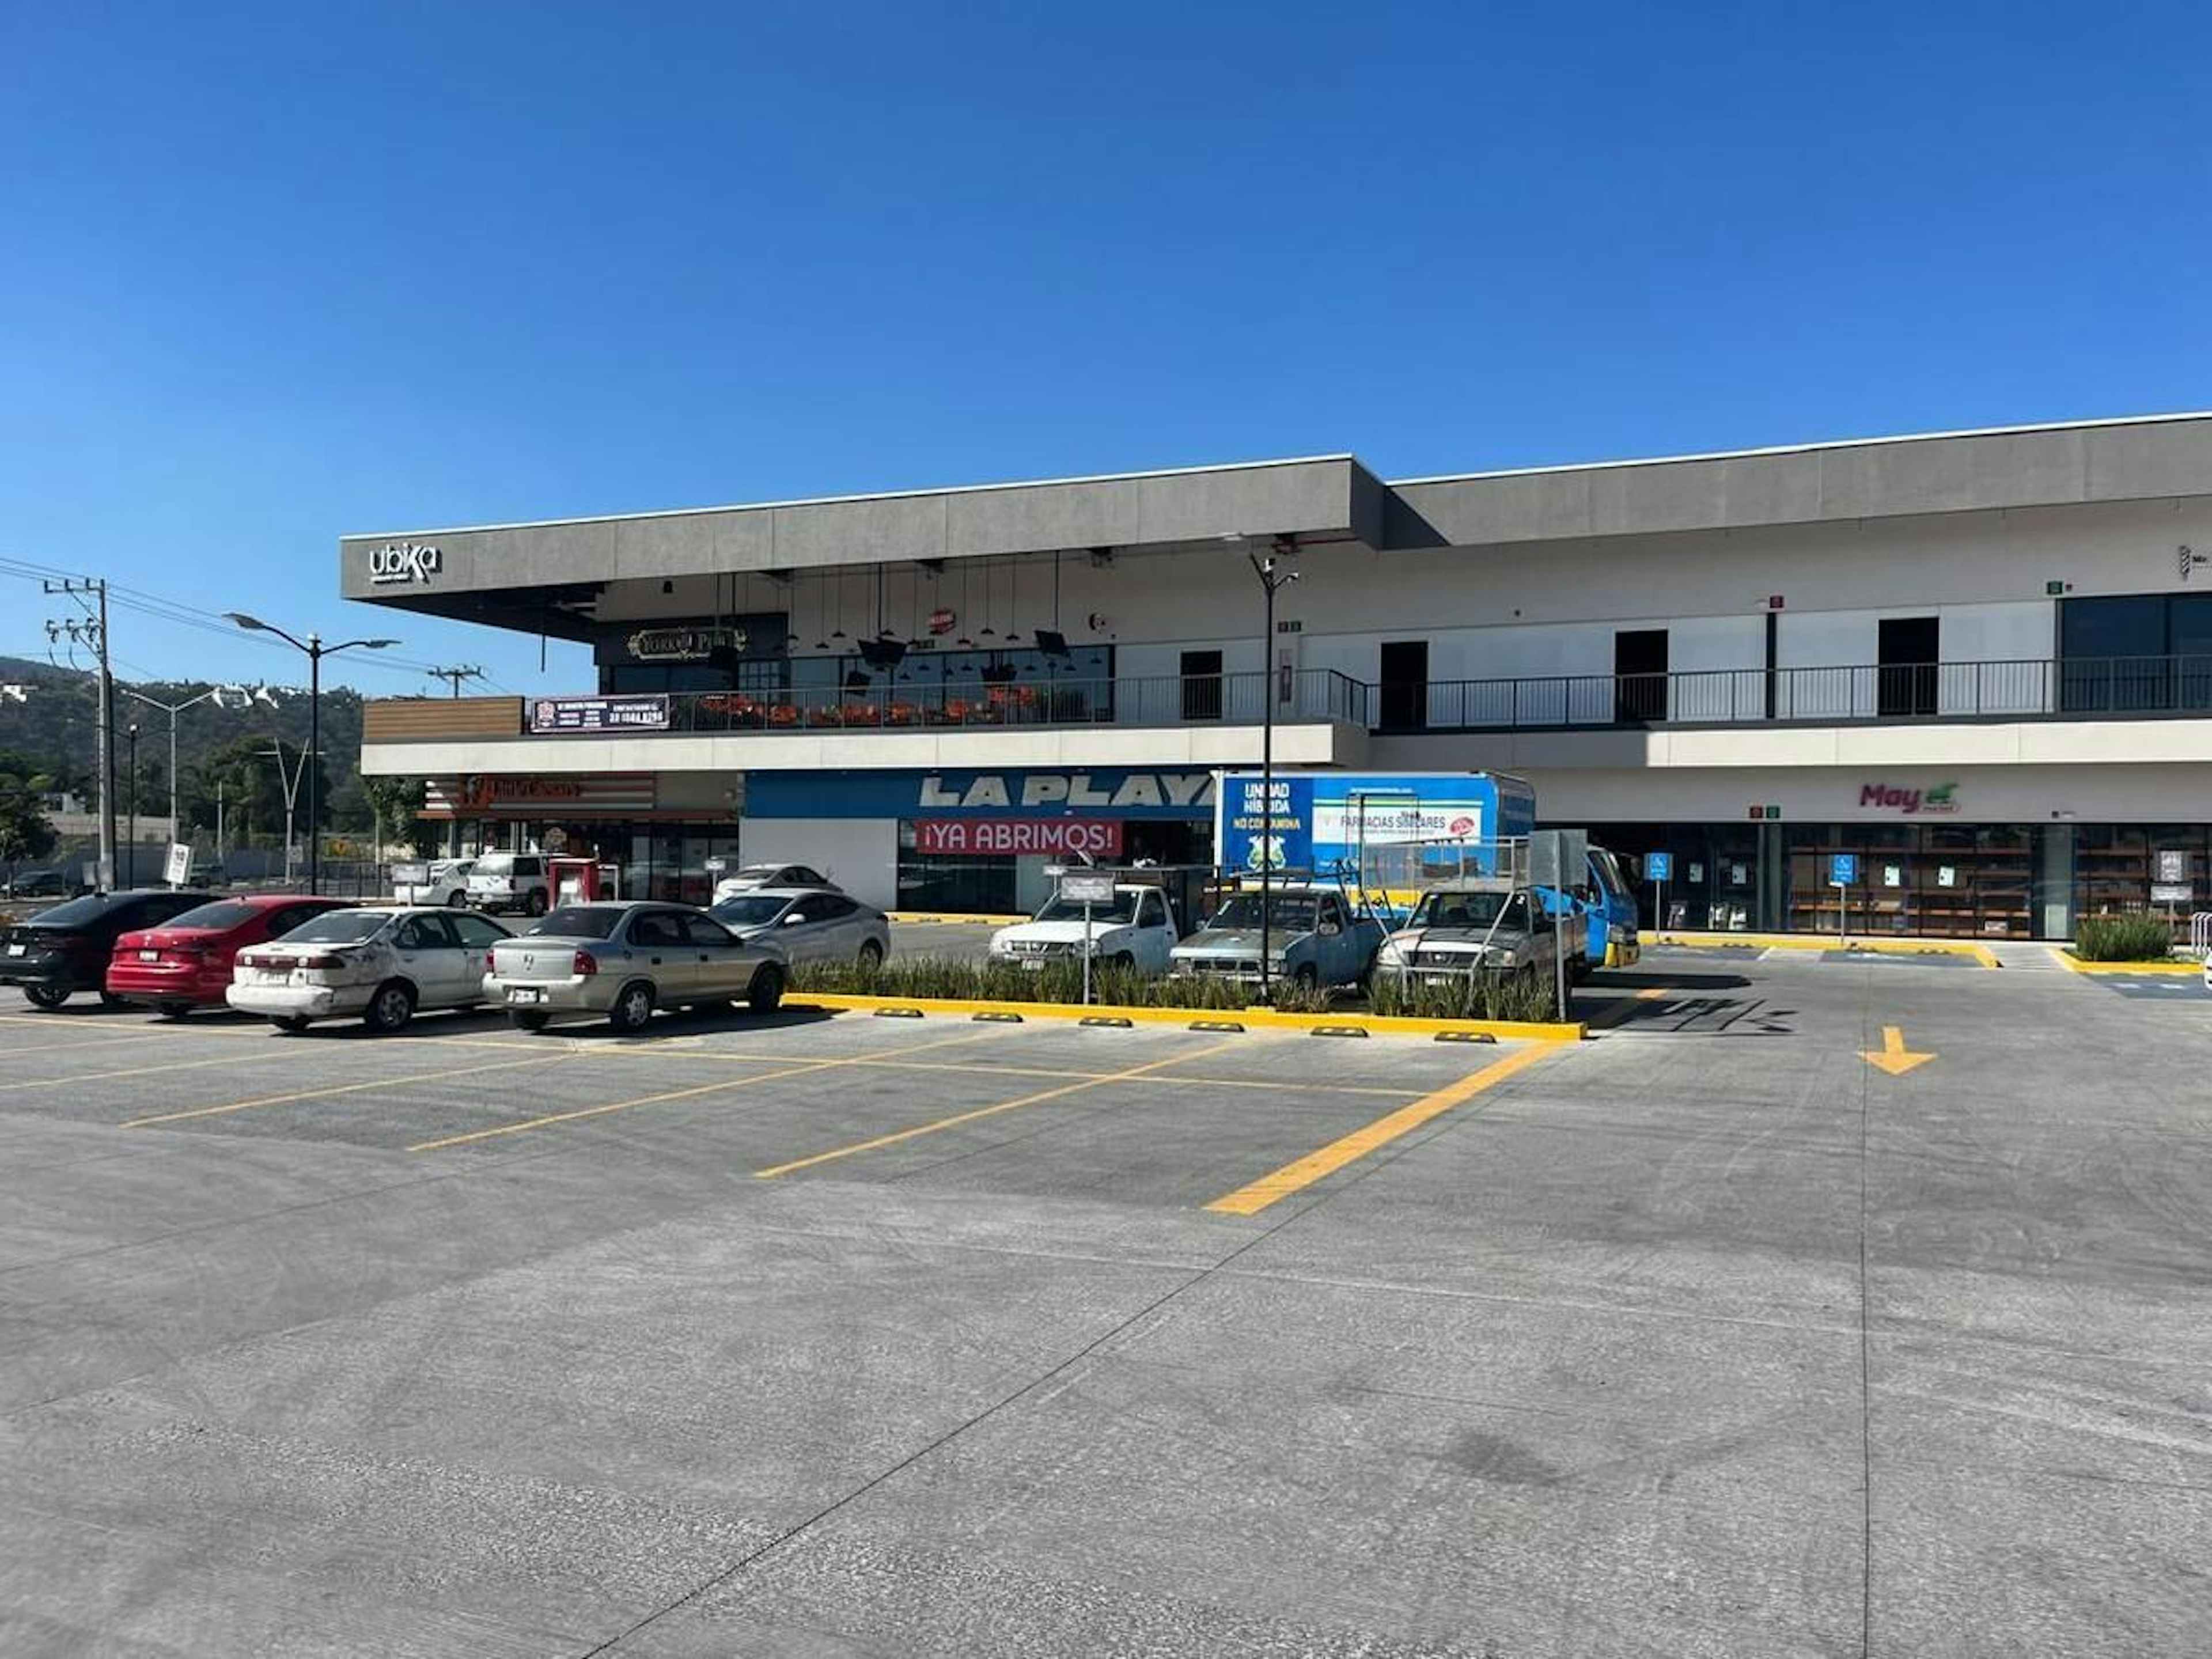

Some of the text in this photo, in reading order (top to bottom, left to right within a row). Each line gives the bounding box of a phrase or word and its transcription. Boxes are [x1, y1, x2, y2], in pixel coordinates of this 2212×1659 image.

[919, 775, 1011, 807] LA
[1860, 783, 1920, 814] May
[924, 823, 1113, 851] ¡YA ABRIMOS!
